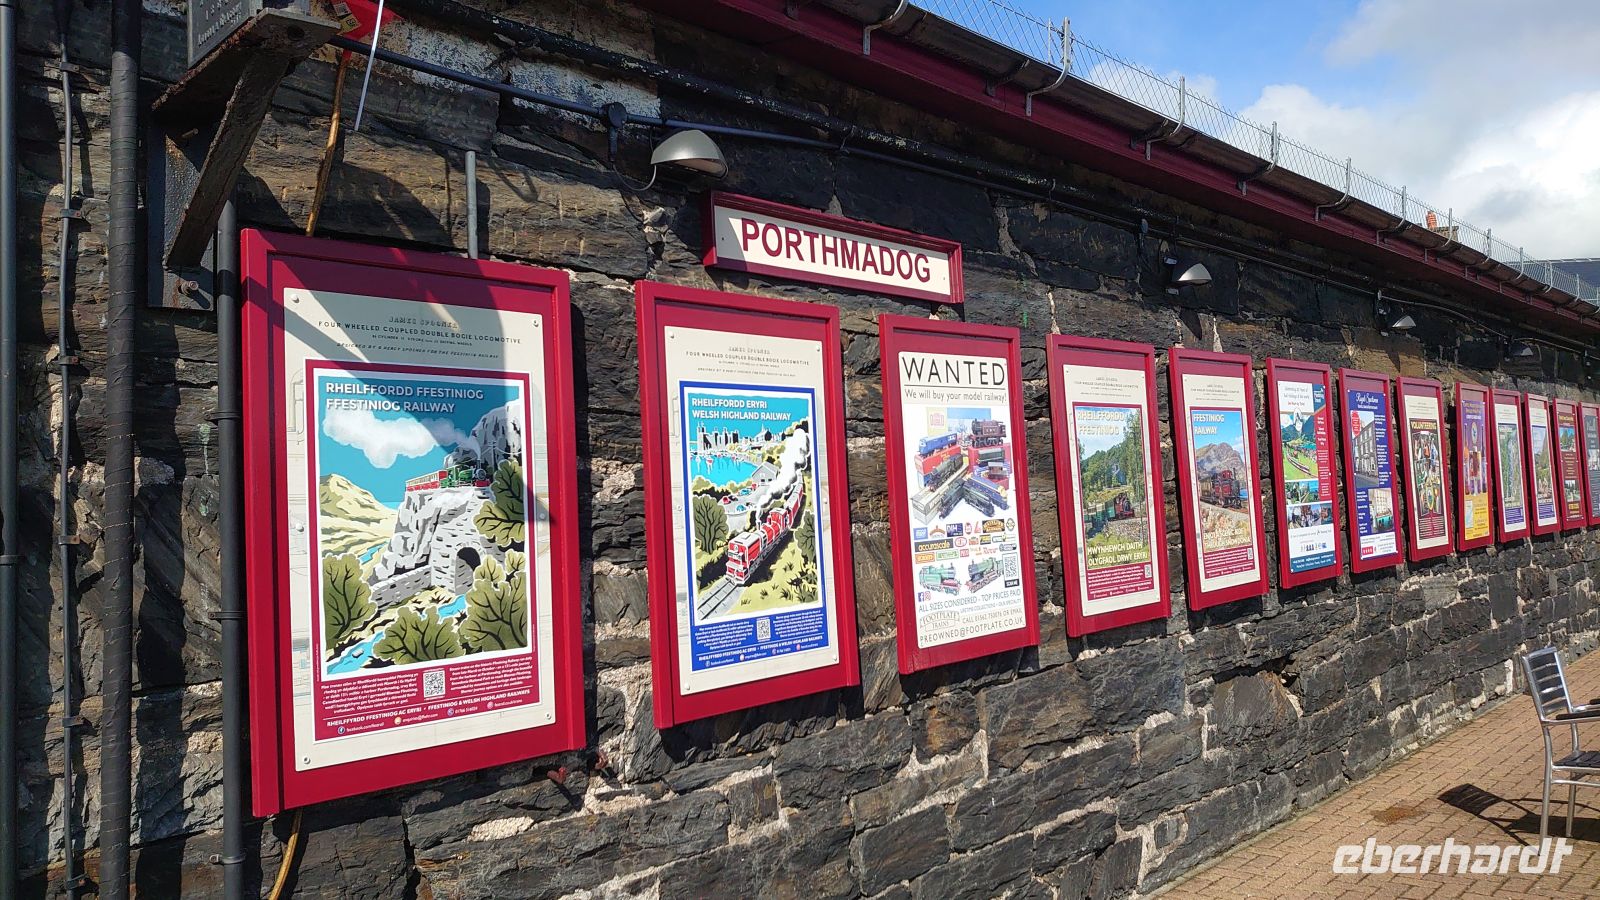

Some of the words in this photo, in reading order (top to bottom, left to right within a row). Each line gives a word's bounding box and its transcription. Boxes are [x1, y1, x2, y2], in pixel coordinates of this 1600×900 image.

[742, 218, 930, 283] PORTHMADOG
[344, 323, 380, 331] WHEELED
[383, 326, 419, 334] COUPLED
[420, 329, 449, 338] DOUBLE
[474, 335, 521, 344] LOCOMOTIVE
[902, 357, 1005, 386] WANTED
[326, 382, 414, 396] RHEILFFORDD
[416, 388, 484, 400] FFESTINIOG
[904, 388, 917, 399] We
[918, 390, 931, 399] will
[933, 391, 944, 400] buy
[947, 393, 960, 402] your
[963, 391, 982, 400] model
[984, 392, 1006, 403] railway!
[326, 398, 401, 412] FFESTINIOG
[404, 402, 456, 413] RAILWAY
[692, 398, 745, 409] RHEILFFORDD
[746, 400, 767, 409] ERYRI
[692, 410, 719, 419] WELSH
[722, 411, 760, 420] HIGHLAND
[761, 412, 791, 421] RAILWAY
[1193, 414, 1224, 423] FFESTINIOG
[1194, 426, 1217, 435] RAILWAY
[918, 540, 950, 551] accurascale
[1088, 544, 1126, 555] MWYNHEWCH
[1127, 542, 1142, 550] DAITH
[1088, 556, 1116, 566] OLYGFAOL
[929, 602, 944, 610] SIZES
[944, 596, 977, 608] CONSIDERED
[992, 591, 1009, 600] PRICES
[922, 610, 956, 626] FOOTPLATE
[327, 716, 365, 726] RHEILFFYRDD
[366, 711, 398, 720] FFESTINIOG
[428, 700, 458, 710] FFESTINIOG
[481, 693, 506, 702] HIGHLAND
